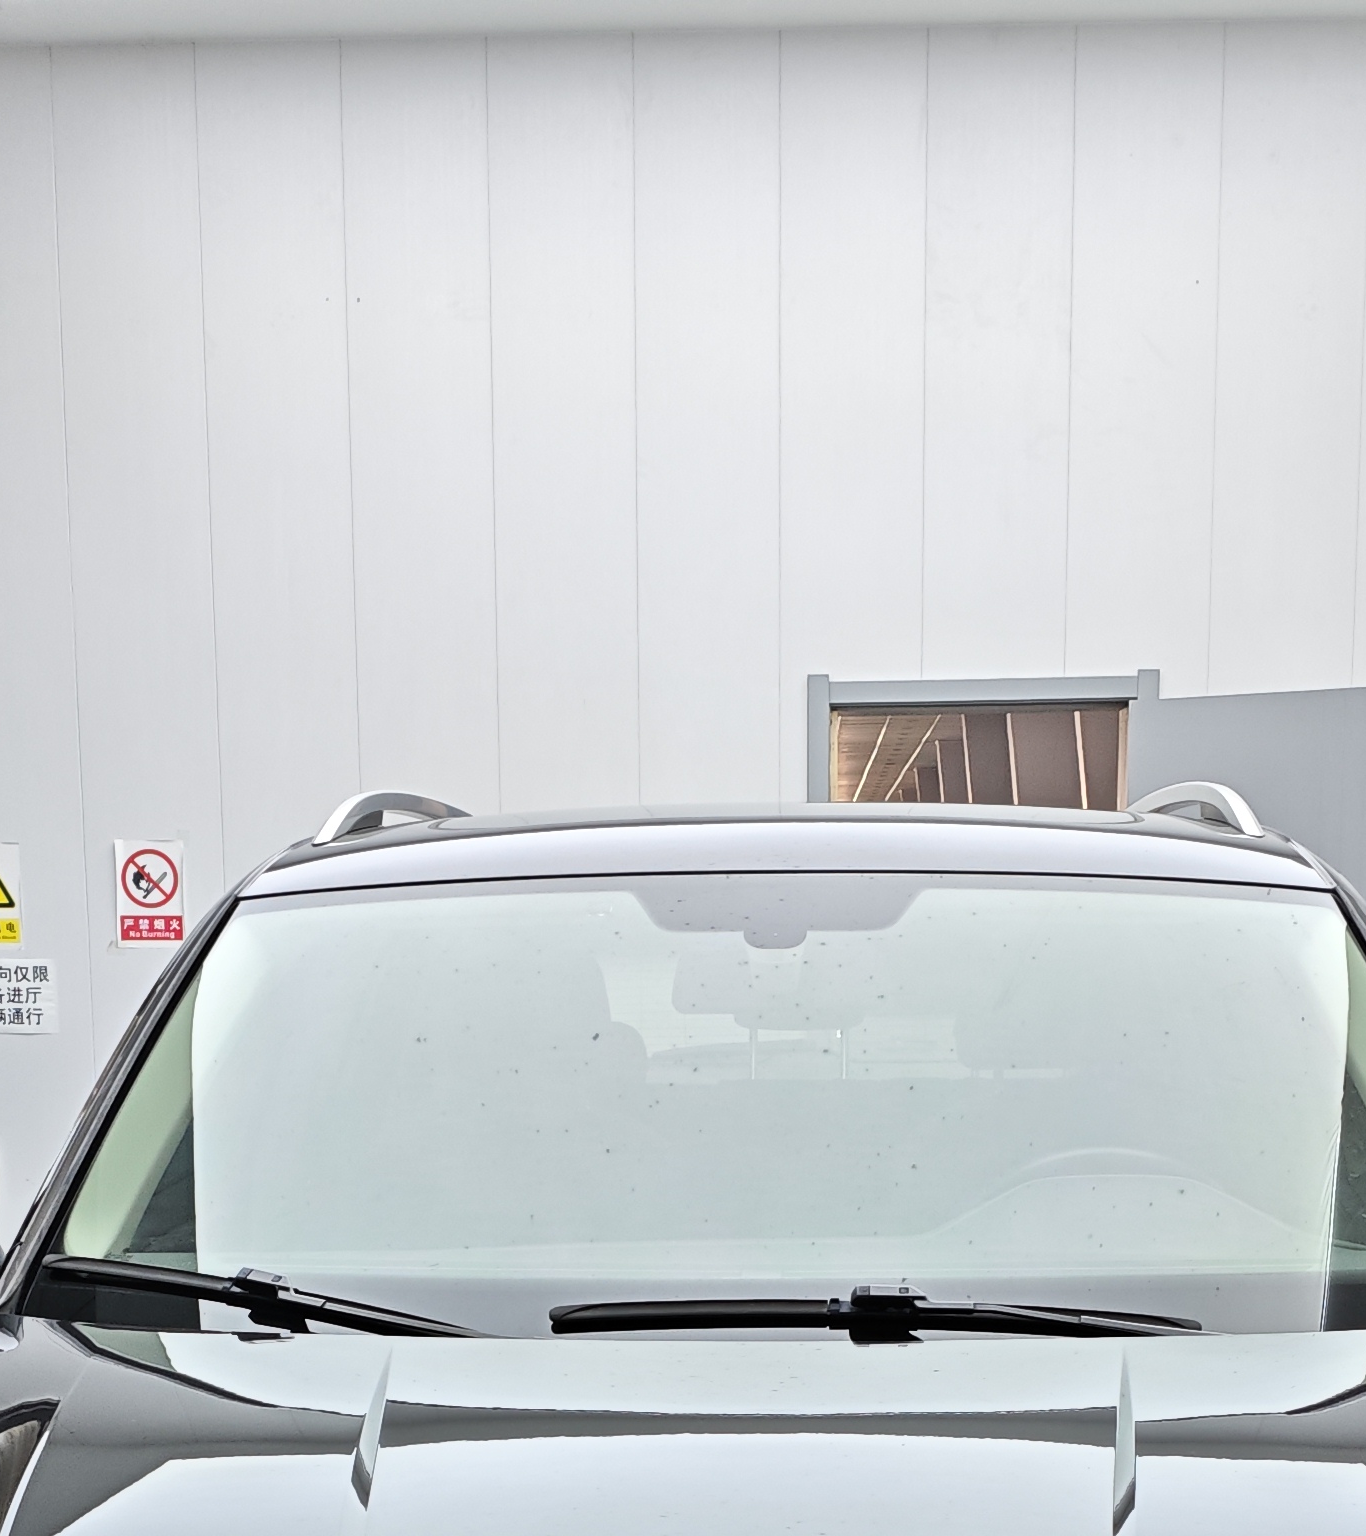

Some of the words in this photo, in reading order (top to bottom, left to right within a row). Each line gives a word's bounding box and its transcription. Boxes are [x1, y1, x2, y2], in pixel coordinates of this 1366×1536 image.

[123, 918, 181, 930] 严禁烟火
[129, 930, 140, 938] No
[142, 930, 175, 939] Burning
